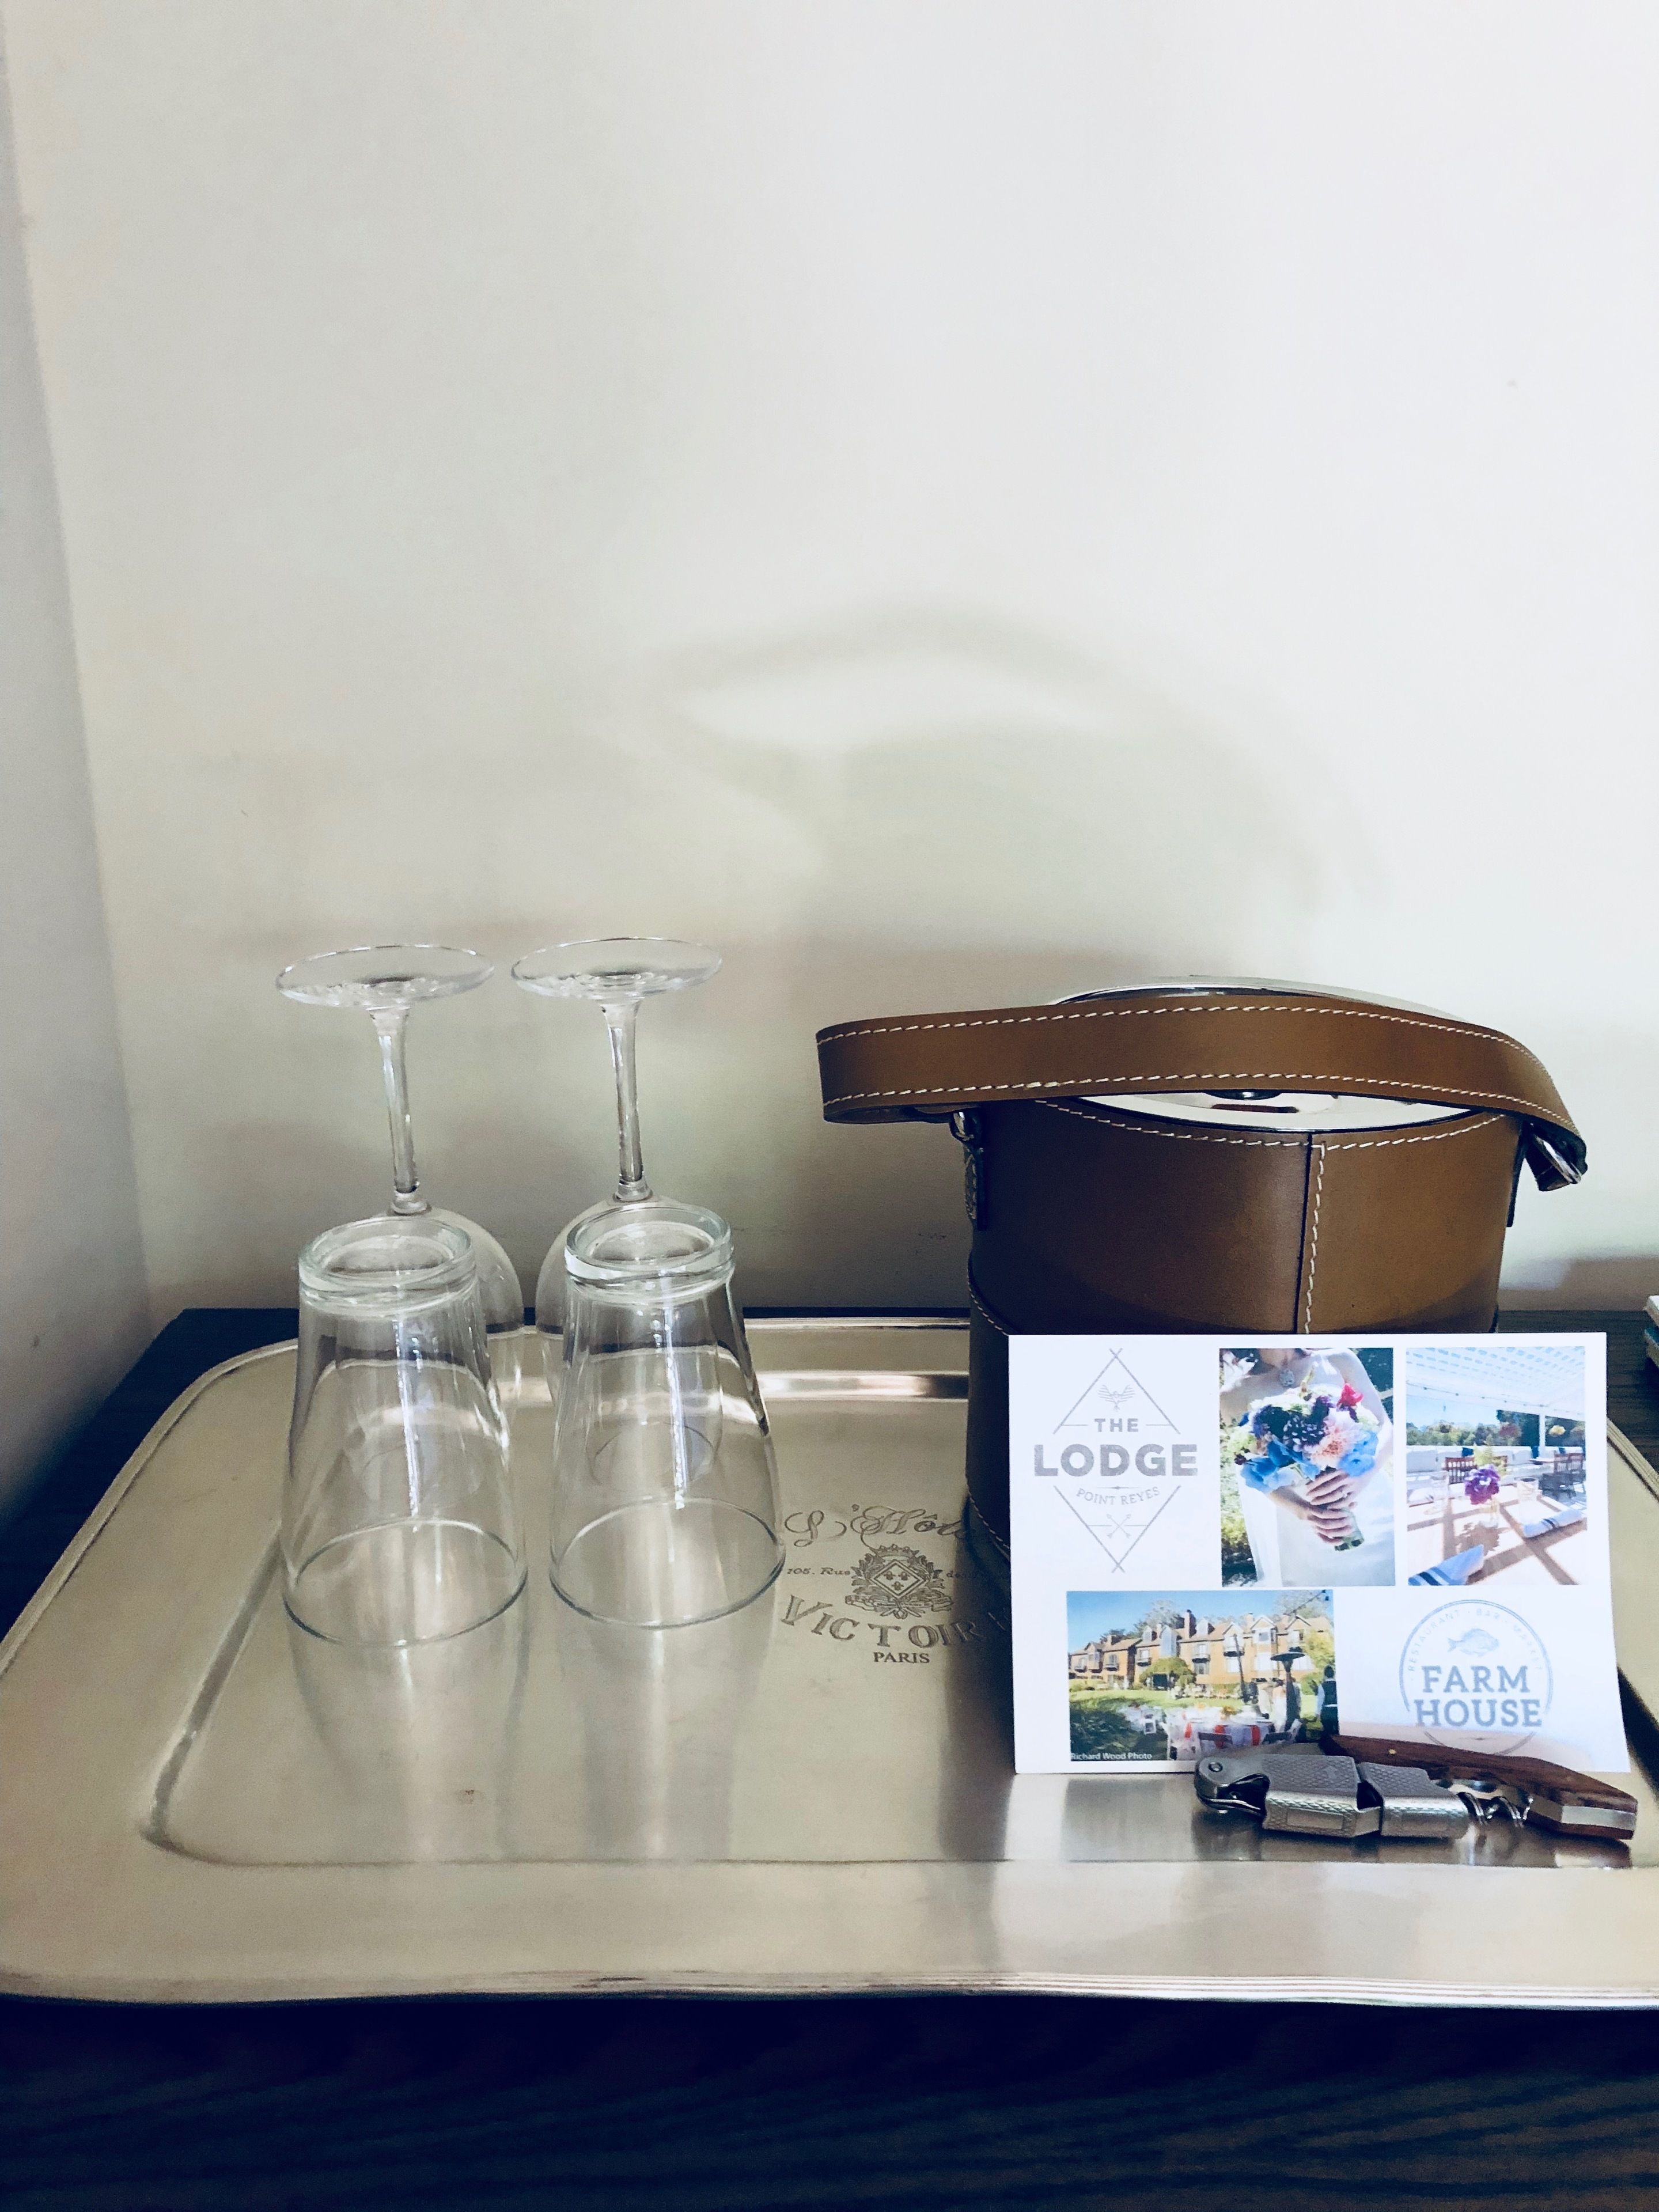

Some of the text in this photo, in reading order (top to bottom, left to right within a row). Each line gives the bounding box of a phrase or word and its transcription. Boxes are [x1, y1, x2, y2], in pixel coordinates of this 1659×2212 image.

[1094, 1418, 1139, 1433] THE
[1033, 1444, 1198, 1477] LODGE
[1075, 1486, 1161, 1506] POINT REYES
[781, 1594, 986, 1649] VICTOIR
[1407, 1609, 1461, 1672] RESTAURANT
[873, 1652, 931, 1664] PARIS
[1421, 1665, 1531, 1694] FARM
[1413, 1699, 1543, 1728] HOUSE
[1070, 1752, 1101, 1760] Richard
[1127, 1752, 1153, 1760] Photo
